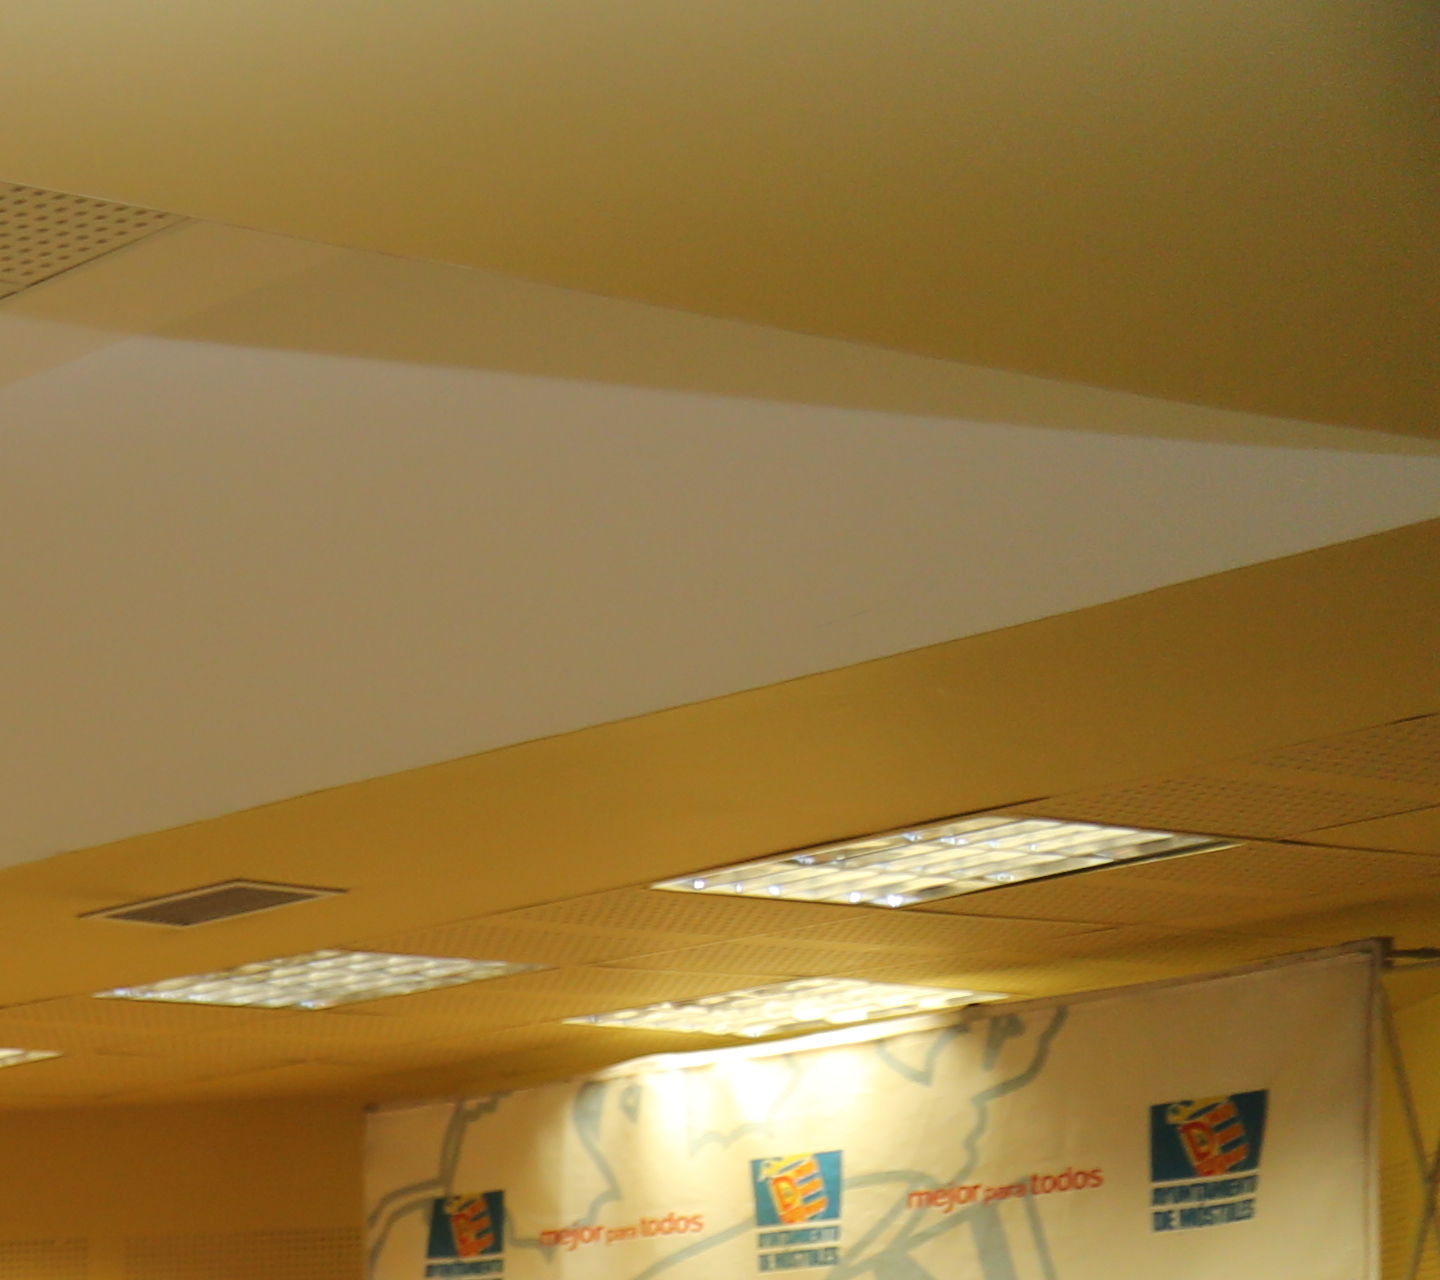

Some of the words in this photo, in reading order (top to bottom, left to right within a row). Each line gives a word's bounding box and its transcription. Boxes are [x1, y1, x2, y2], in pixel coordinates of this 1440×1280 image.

[907, 1183, 981, 1213] mejor
[984, 1183, 1026, 1204] para
[1030, 1167, 1104, 1196] todos
[540, 1223, 604, 1250] mejor
[607, 1225, 636, 1244] para
[639, 1212, 704, 1238] todos
